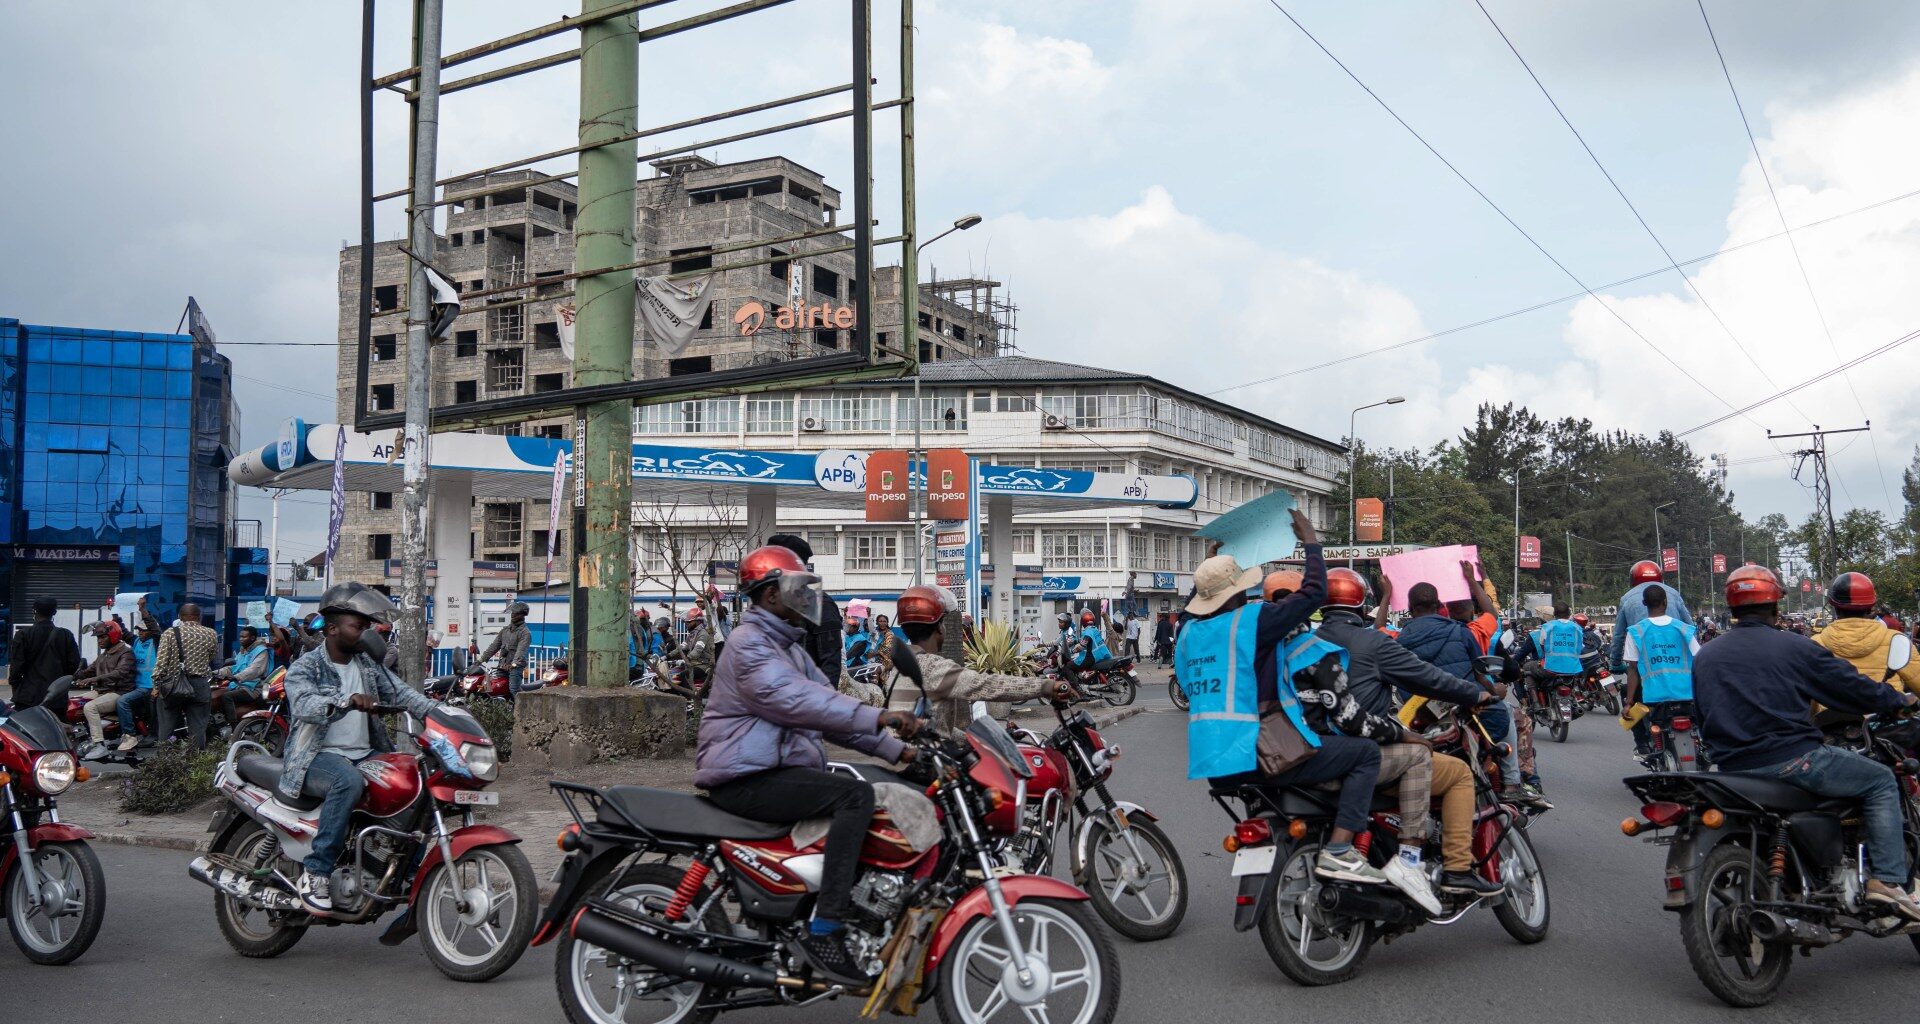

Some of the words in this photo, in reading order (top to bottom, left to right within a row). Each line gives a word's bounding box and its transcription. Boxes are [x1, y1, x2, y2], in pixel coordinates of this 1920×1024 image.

[775, 299, 857, 329] airte
[821, 467, 854, 483] APB
[869, 492, 906, 503] m-pesa
[929, 491, 966, 503] m-pesa
[1123, 486, 1141, 498] APB
[34, 549, 101, 559] MATELAS
[937, 549, 949, 559] TYRE
[949, 548, 965, 558] CENTRE
[1323, 549, 1360, 559] JAMBO
